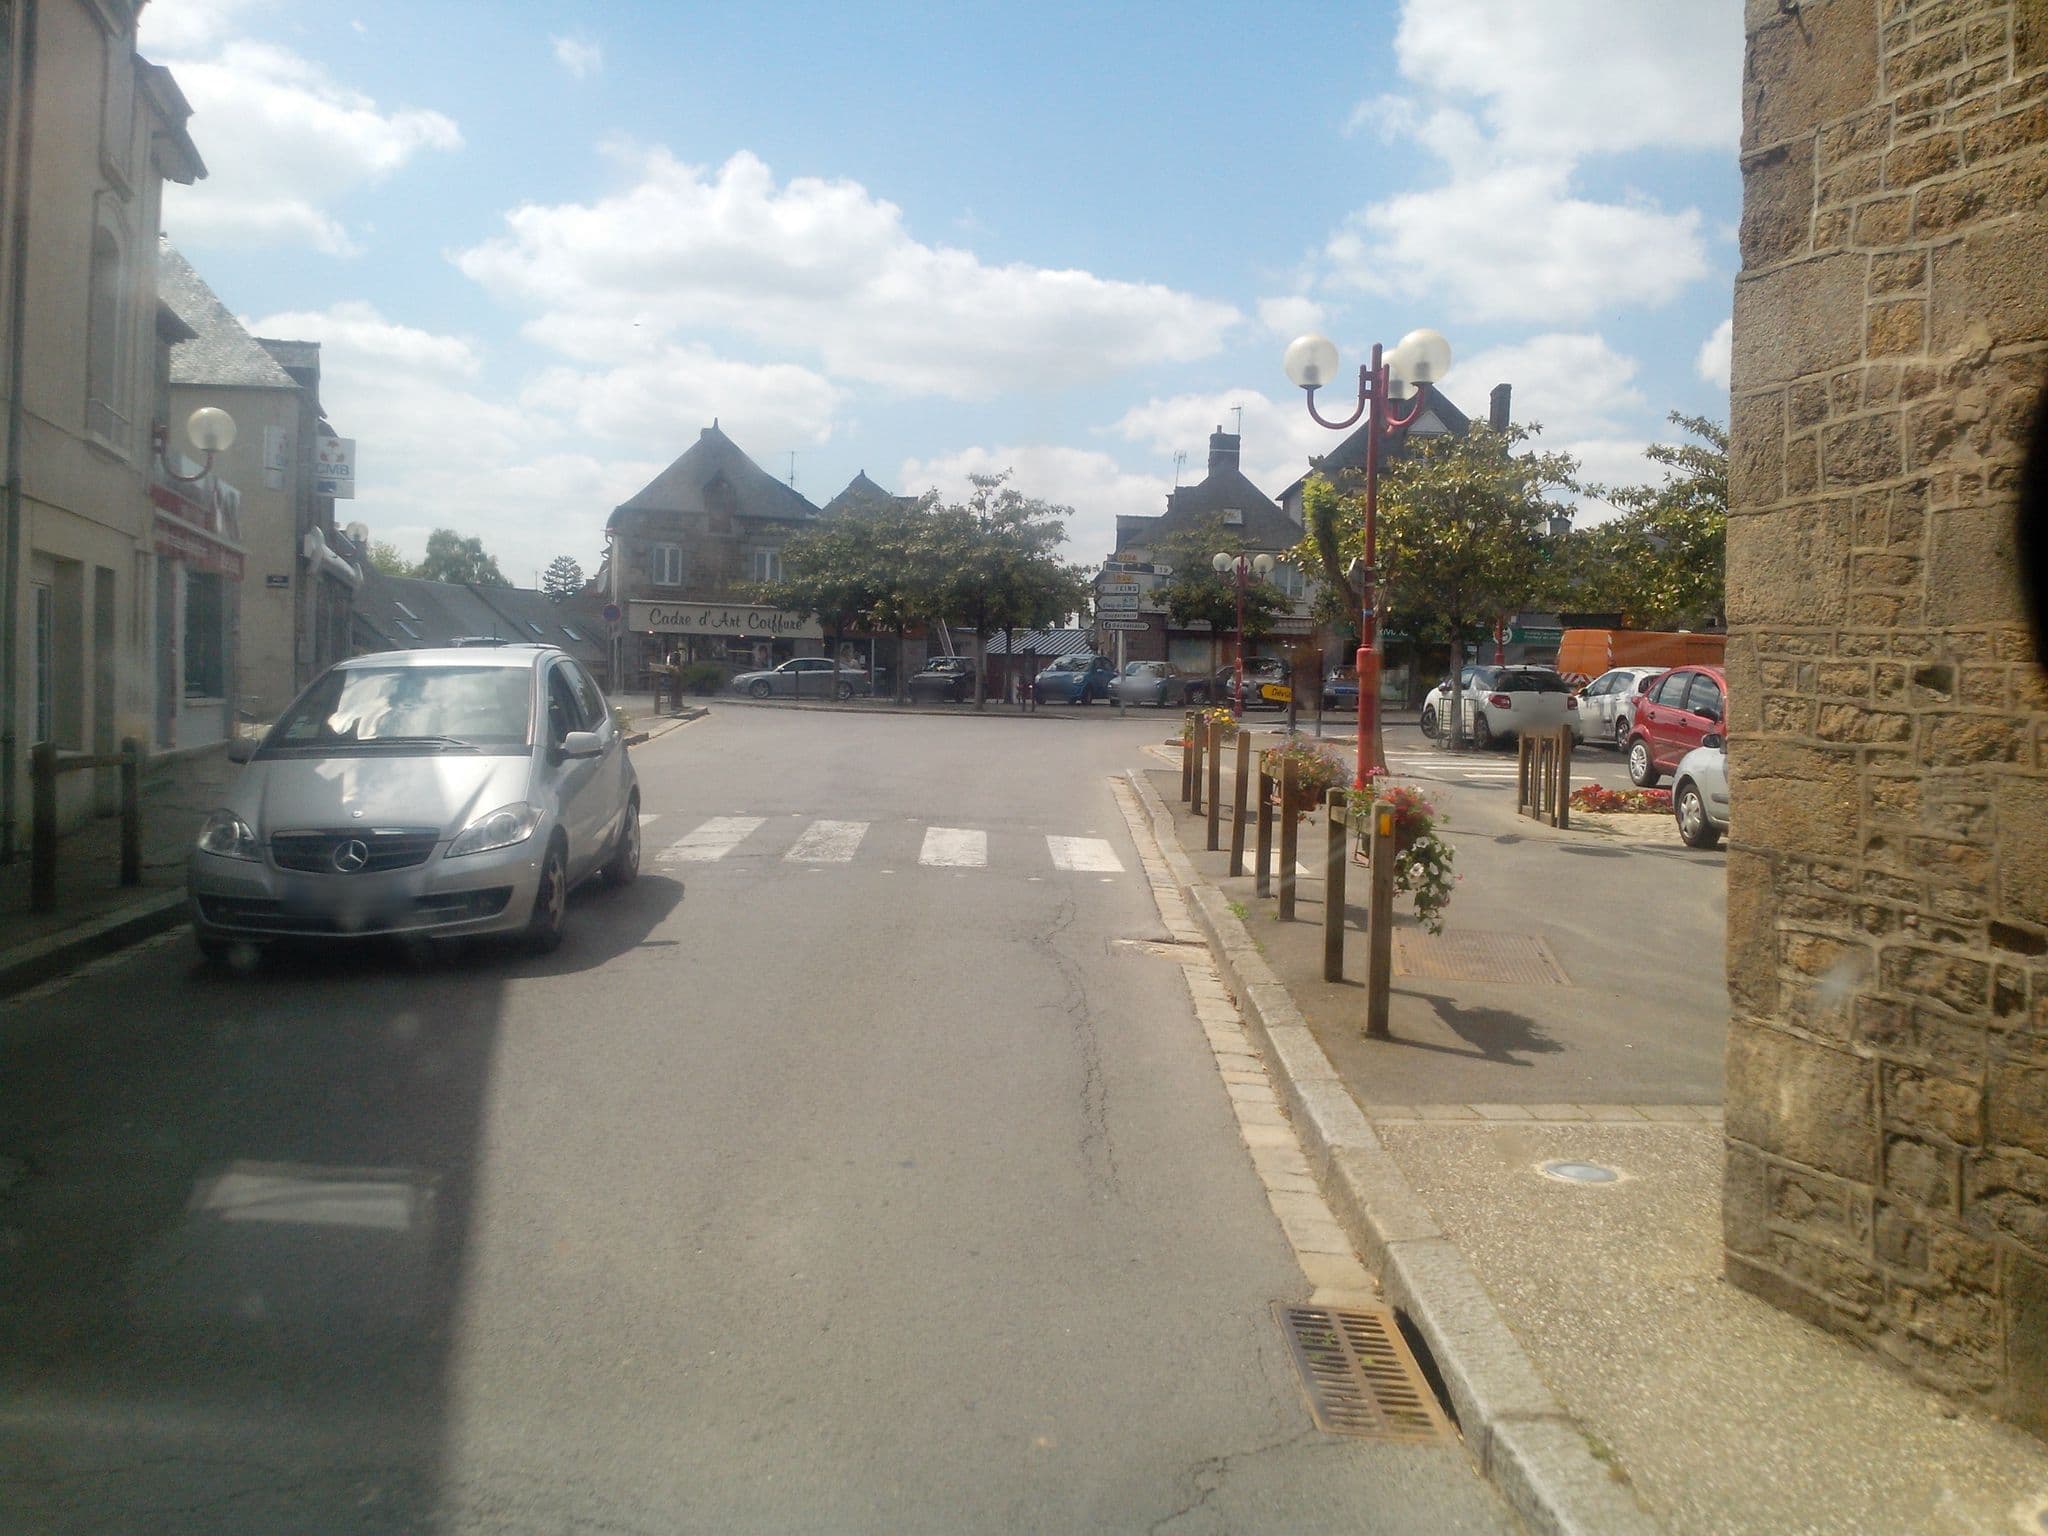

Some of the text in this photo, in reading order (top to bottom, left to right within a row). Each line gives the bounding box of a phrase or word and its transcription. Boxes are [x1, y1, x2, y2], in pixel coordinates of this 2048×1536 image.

[315, 463, 350, 476] CMB
[649, 607, 802, 633] Cadre d'Art Coiffure
